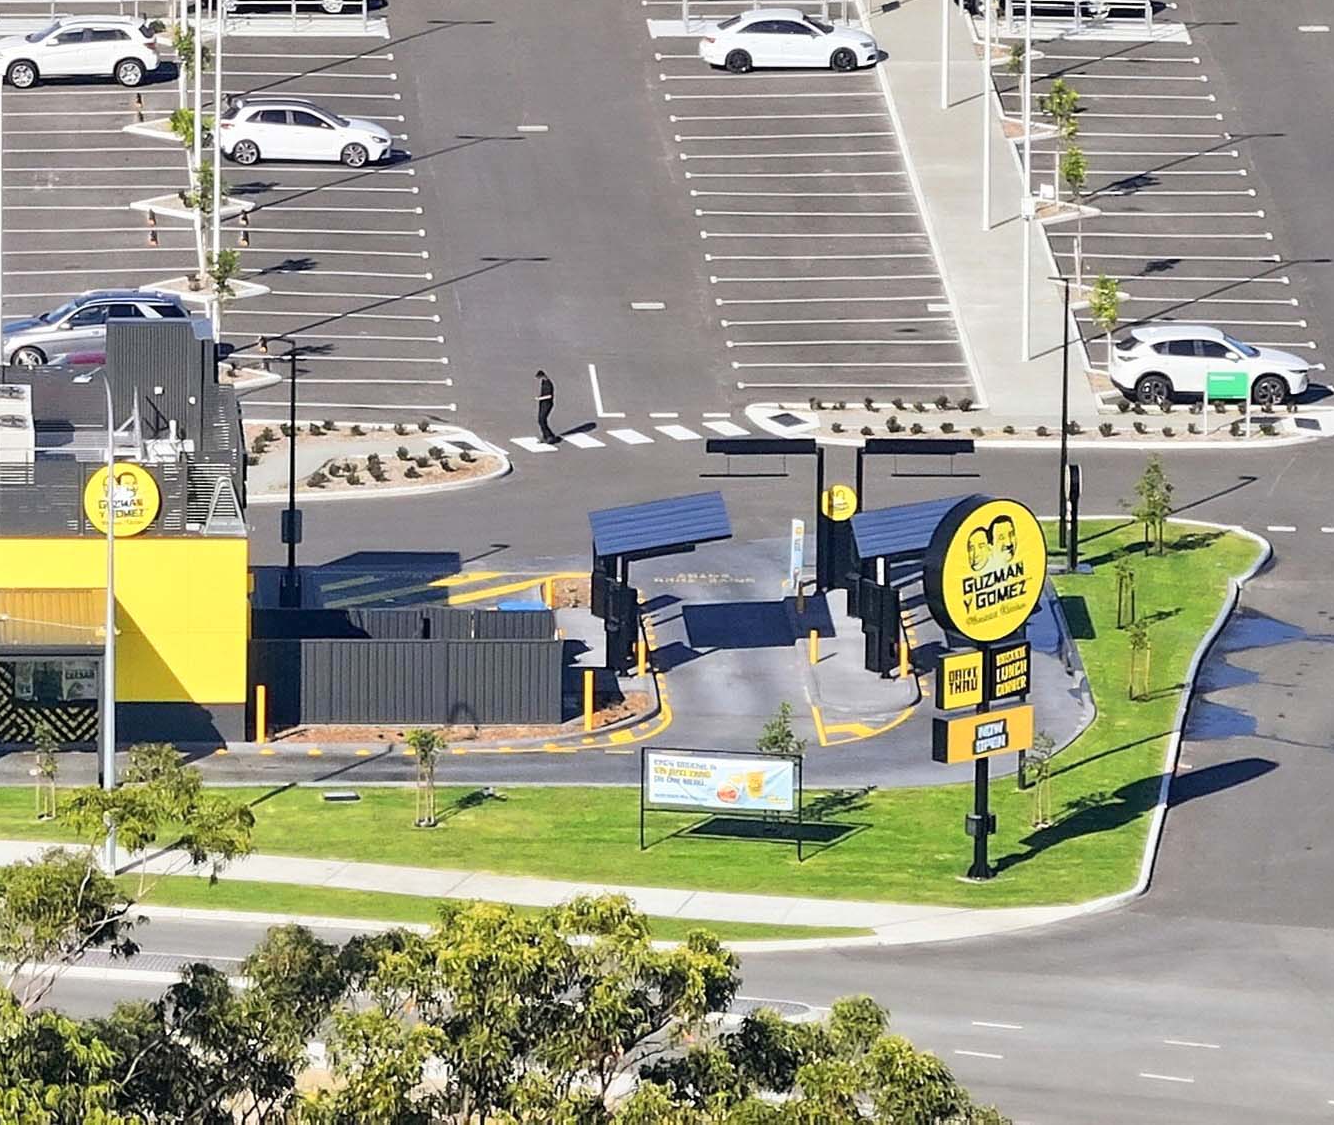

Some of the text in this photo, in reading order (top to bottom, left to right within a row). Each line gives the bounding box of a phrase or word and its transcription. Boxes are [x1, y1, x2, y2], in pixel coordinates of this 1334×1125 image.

[962, 563, 1024, 595] GUZMAN
[975, 580, 1026, 610] GOMEZ
[996, 659, 1027, 683] LUNCH
